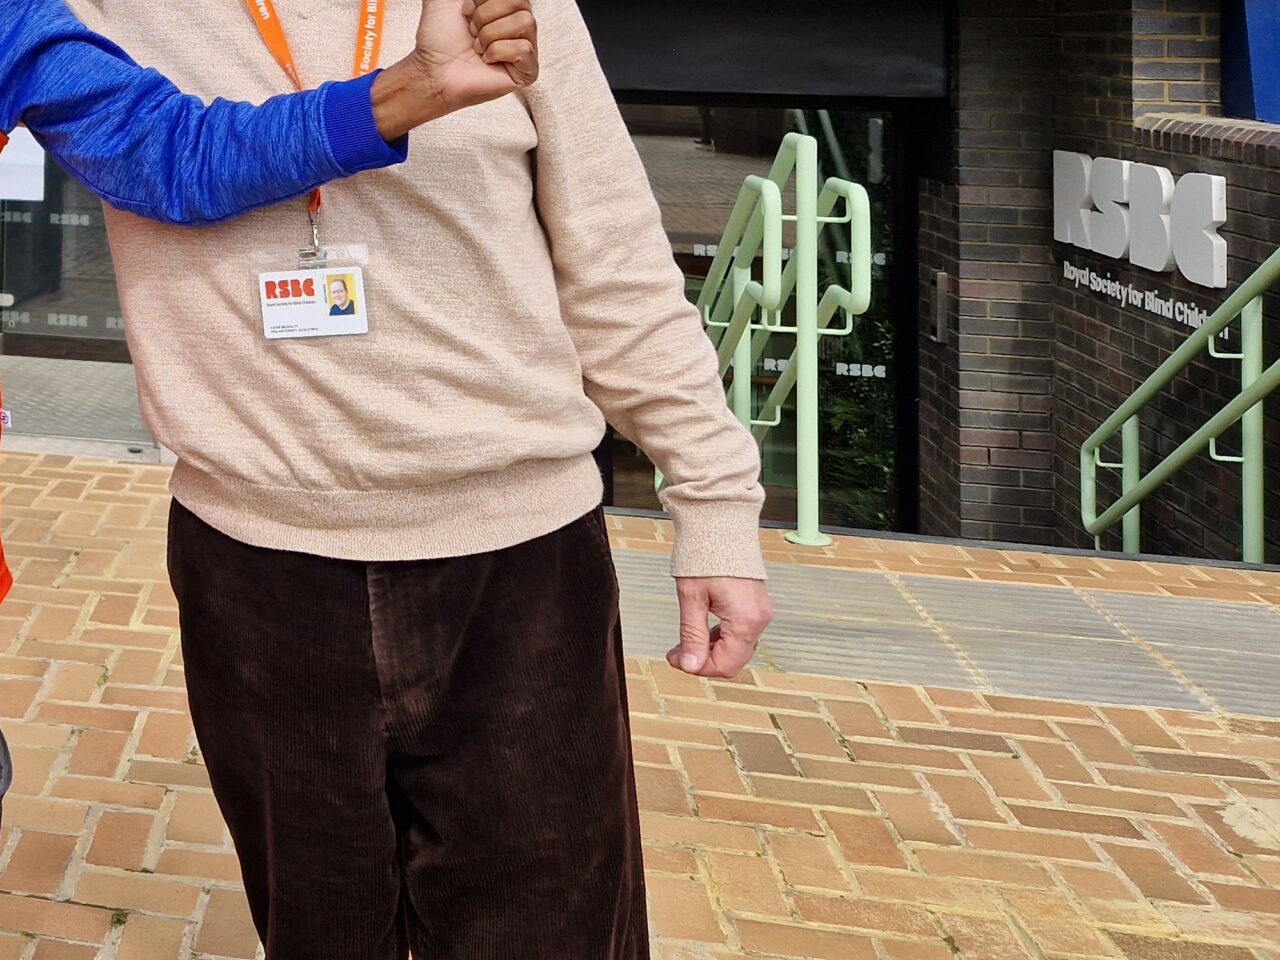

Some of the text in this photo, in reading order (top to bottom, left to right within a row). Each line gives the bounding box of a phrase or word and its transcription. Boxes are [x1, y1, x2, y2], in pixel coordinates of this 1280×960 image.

[365, 14, 377, 29] for
[360, 29, 376, 71] Society
[1053, 149, 1228, 289] RSBC
[265, 278, 315, 300] RSBC
[1063, 260, 1089, 288] Royal
[1090, 271, 1127, 307] Society
[1127, 283, 1145, 307] for
[1144, 289, 1173, 322] Blind
[836, 362, 886, 378] RSBC
